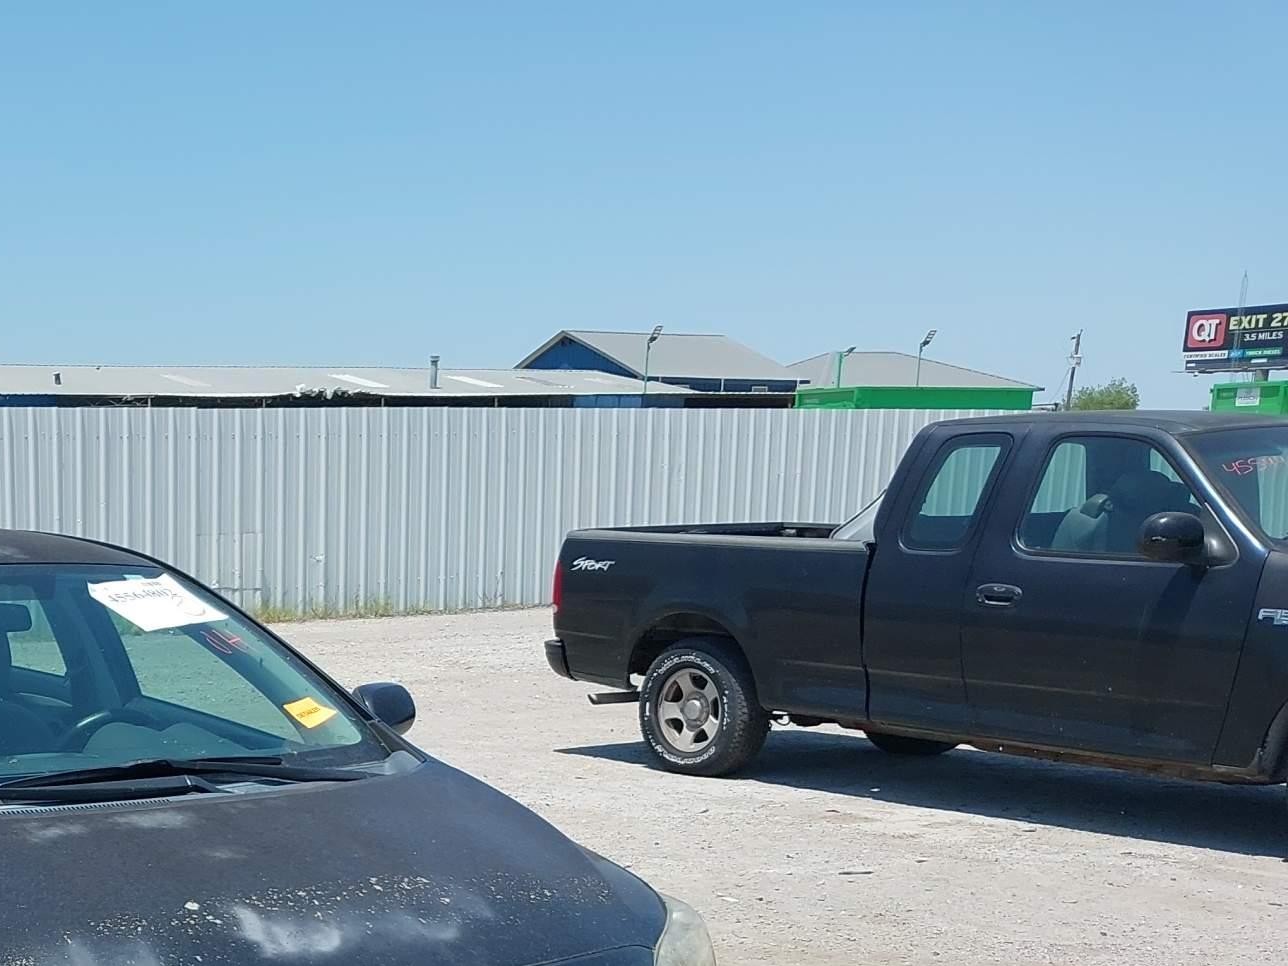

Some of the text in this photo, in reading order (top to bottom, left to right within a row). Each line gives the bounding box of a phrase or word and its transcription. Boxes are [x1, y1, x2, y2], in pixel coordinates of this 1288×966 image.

[1229, 314, 1268, 330] EXIT
[1192, 318, 1220, 343] QT
[1257, 331, 1284, 340] MILES
